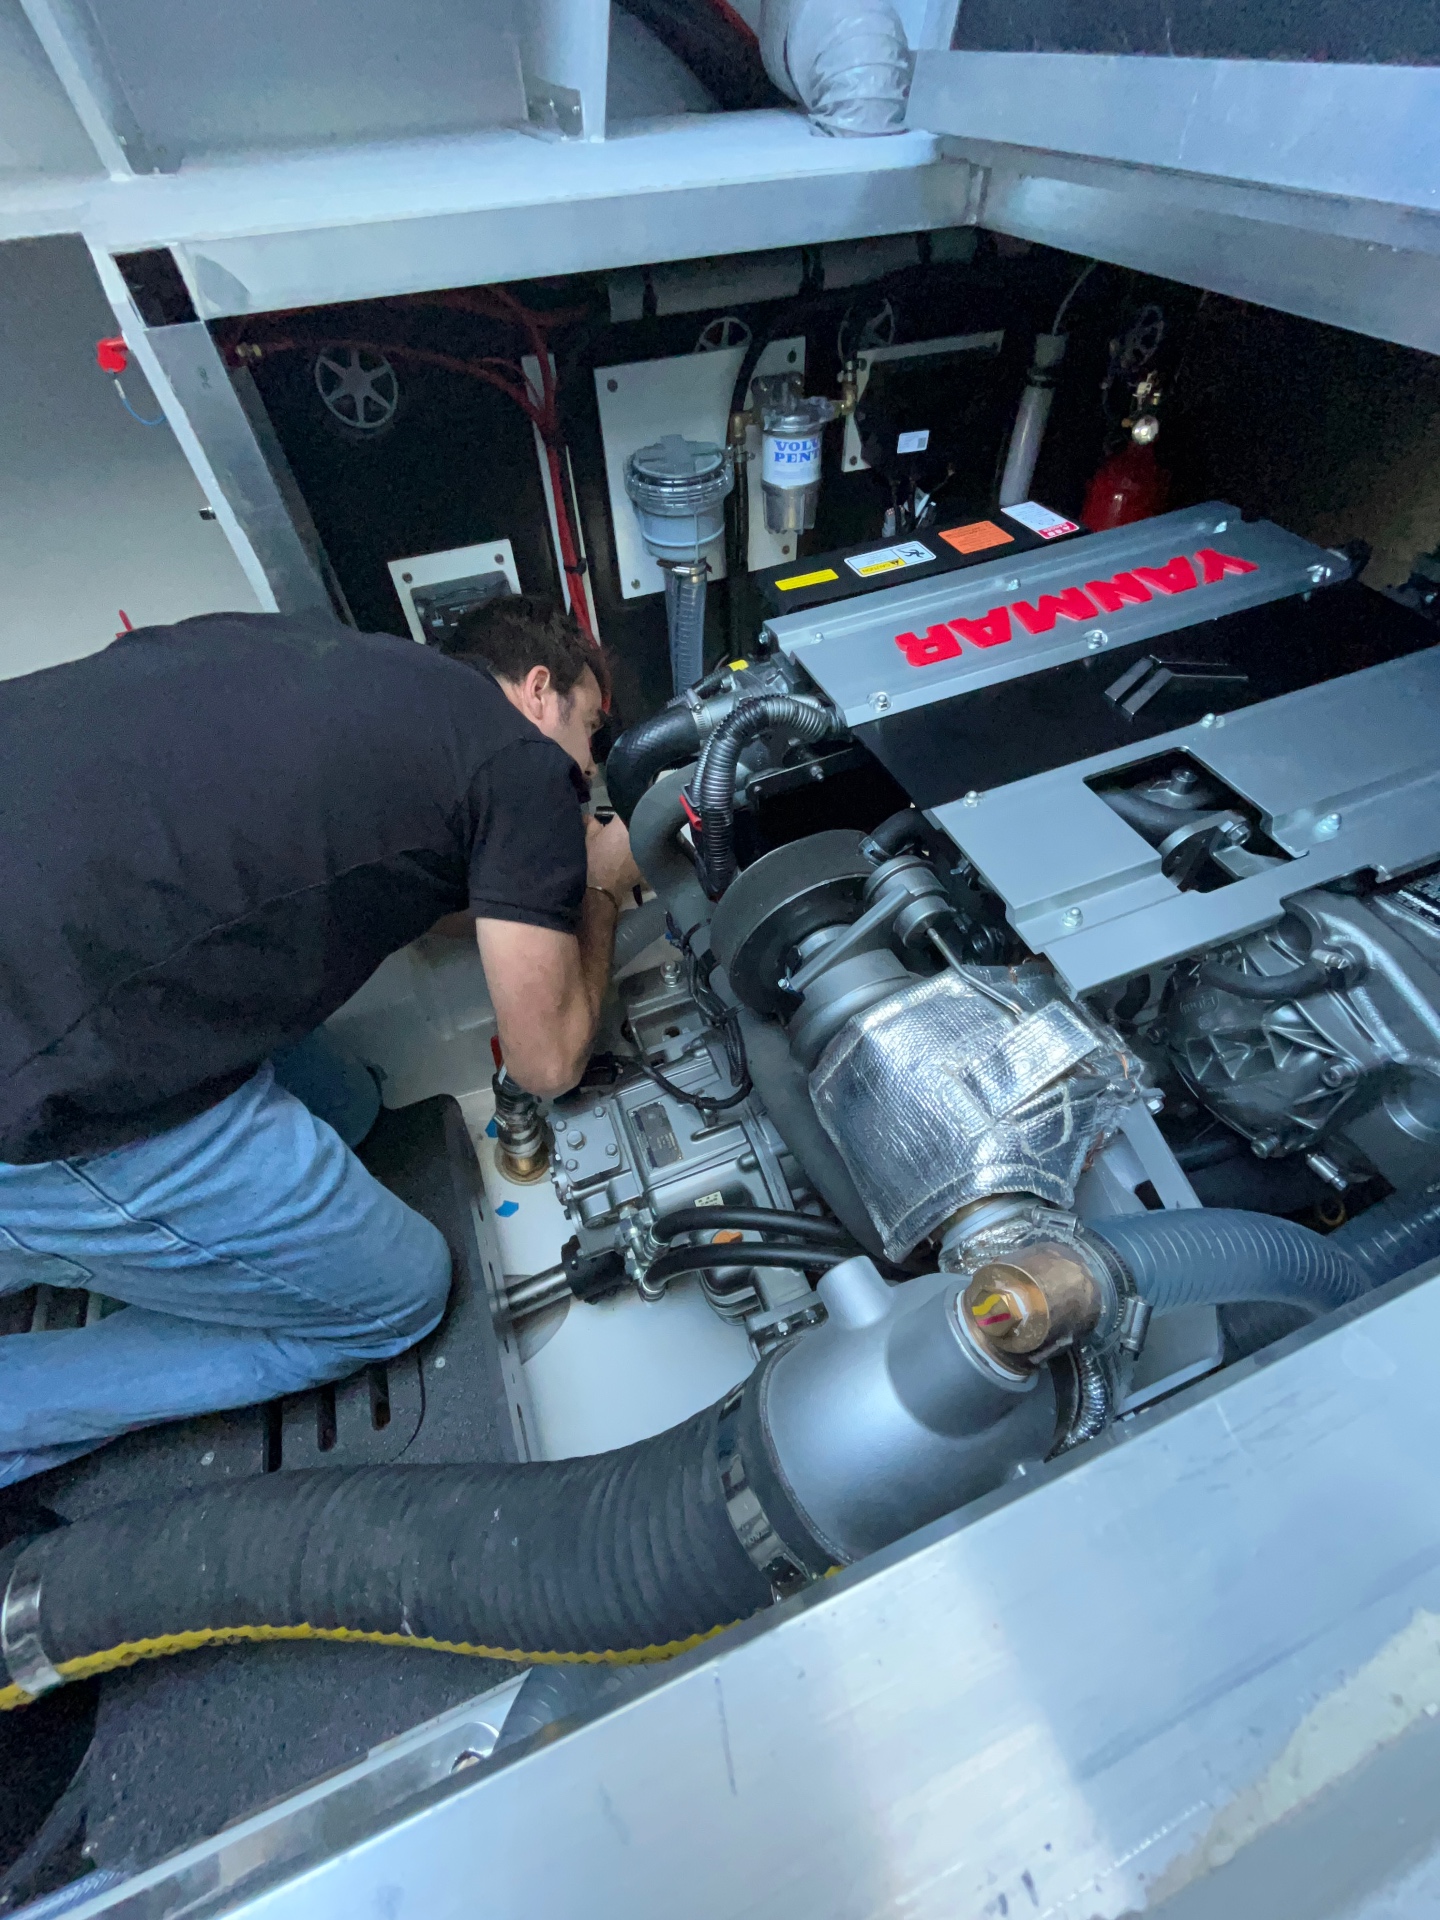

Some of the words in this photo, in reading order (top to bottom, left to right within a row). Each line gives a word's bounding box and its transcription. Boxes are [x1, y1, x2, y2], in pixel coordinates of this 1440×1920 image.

[774, 438, 819, 452] VOLV
[774, 449, 819, 463] PENT
[894, 547, 1258, 667] YANMAR
